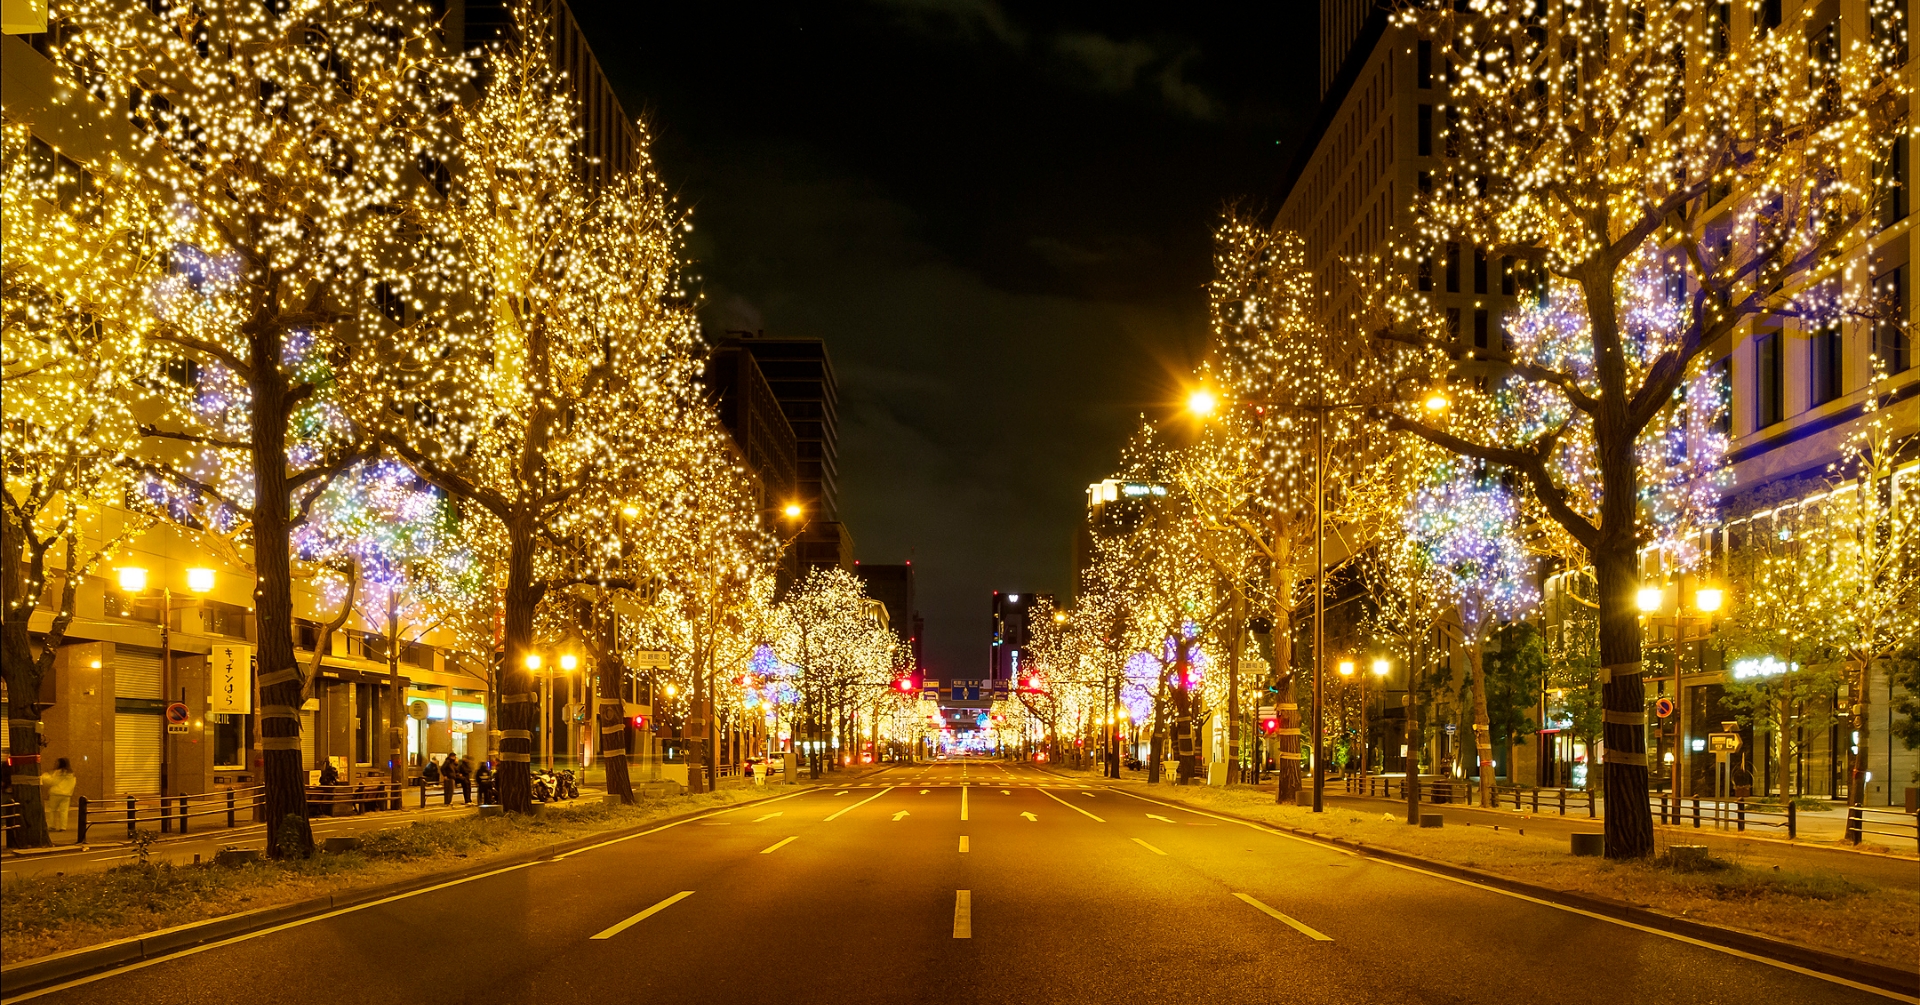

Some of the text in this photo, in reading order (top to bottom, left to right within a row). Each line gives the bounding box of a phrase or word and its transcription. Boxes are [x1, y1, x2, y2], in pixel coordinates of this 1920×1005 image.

[224, 647, 235, 706] キッチンはら
